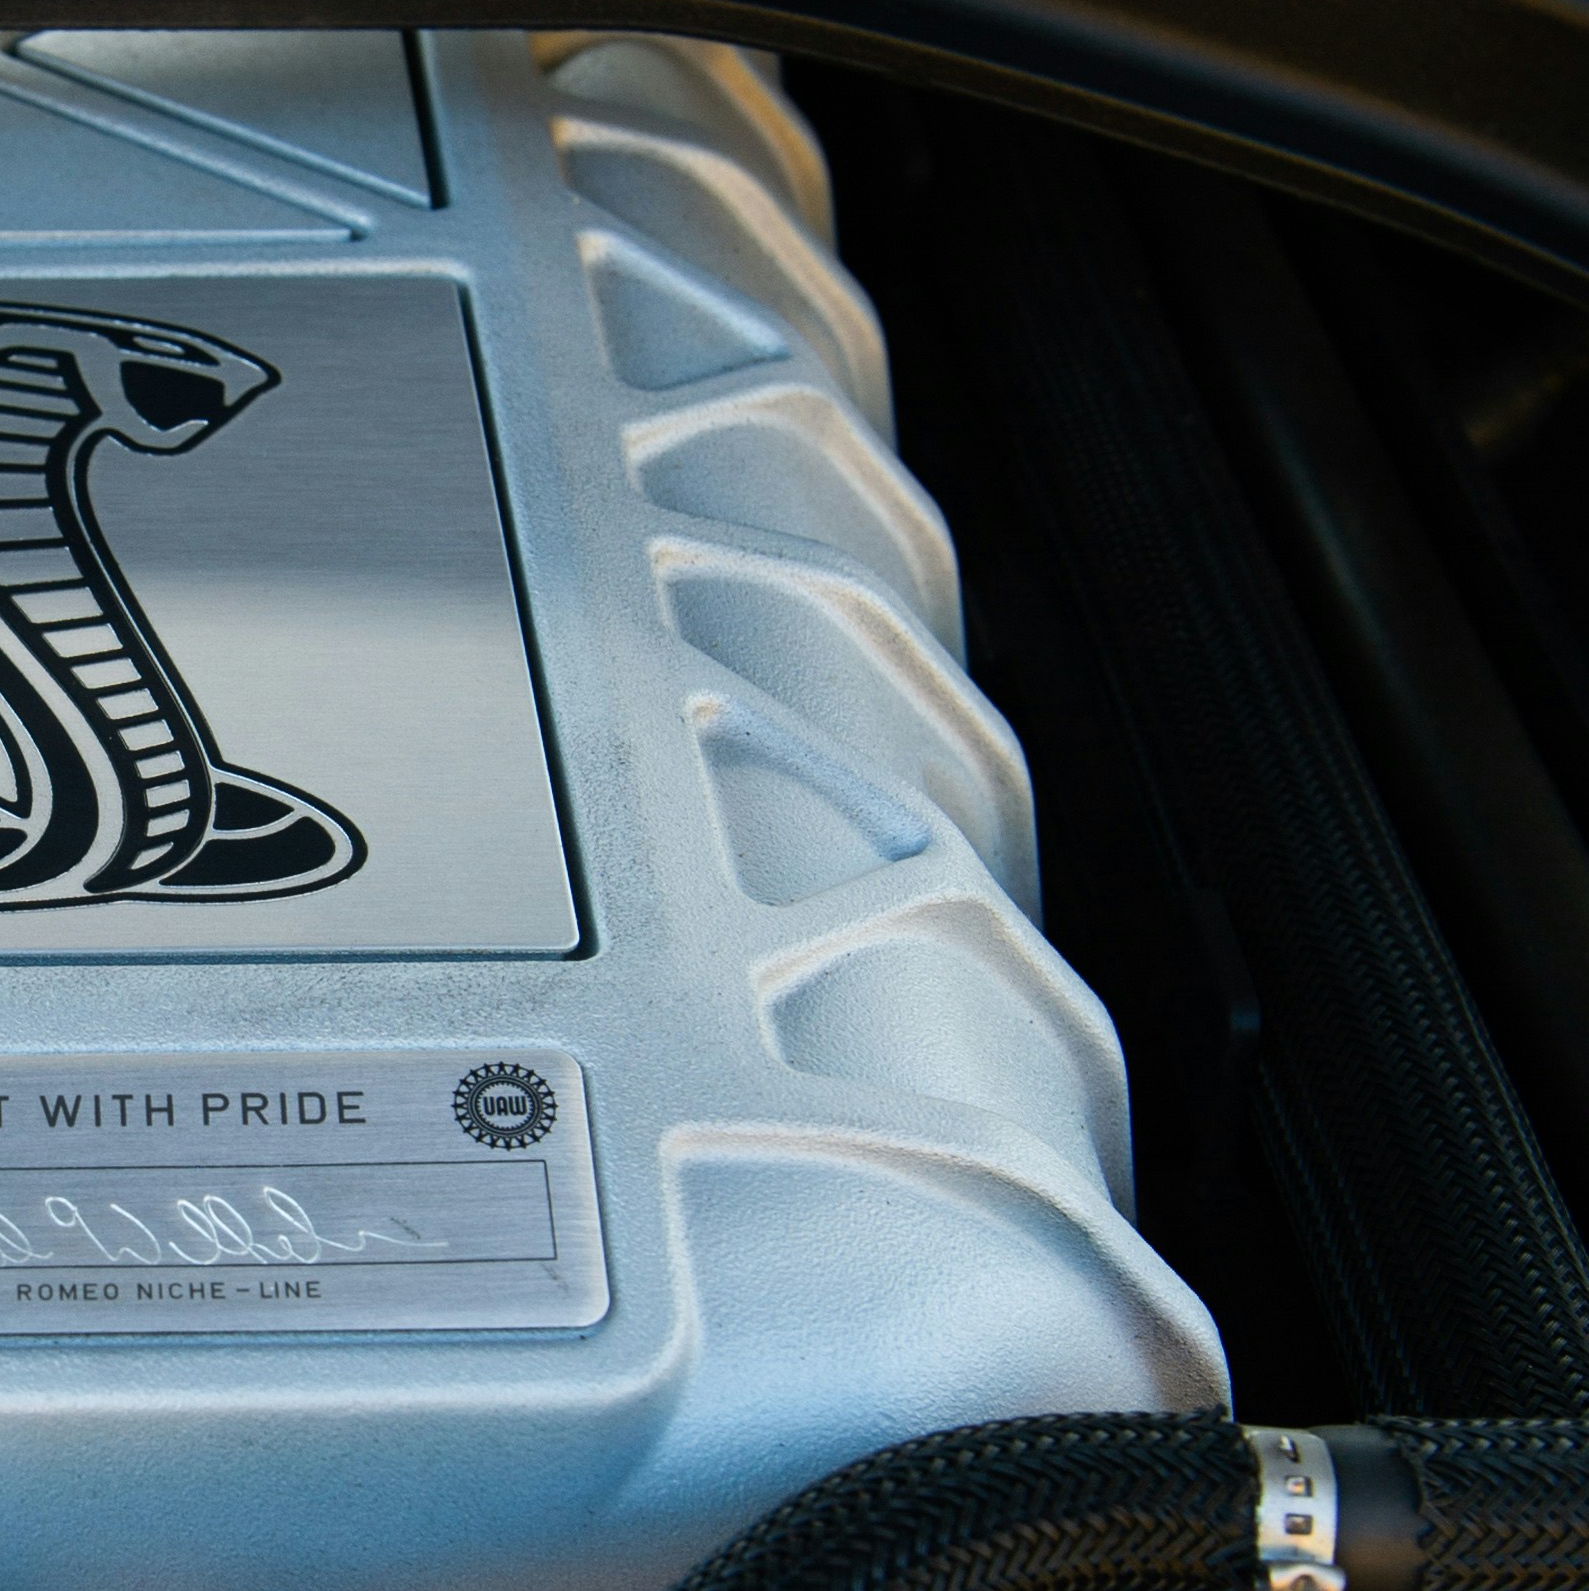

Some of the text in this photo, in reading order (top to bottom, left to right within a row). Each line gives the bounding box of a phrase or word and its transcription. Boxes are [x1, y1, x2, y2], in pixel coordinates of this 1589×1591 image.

[39, 1092, 175, 1127] WITH
[201, 1090, 367, 1126] PRIDE
[483, 1096, 528, 1116] UAW
[16, 1283, 119, 1301] ROMEO
